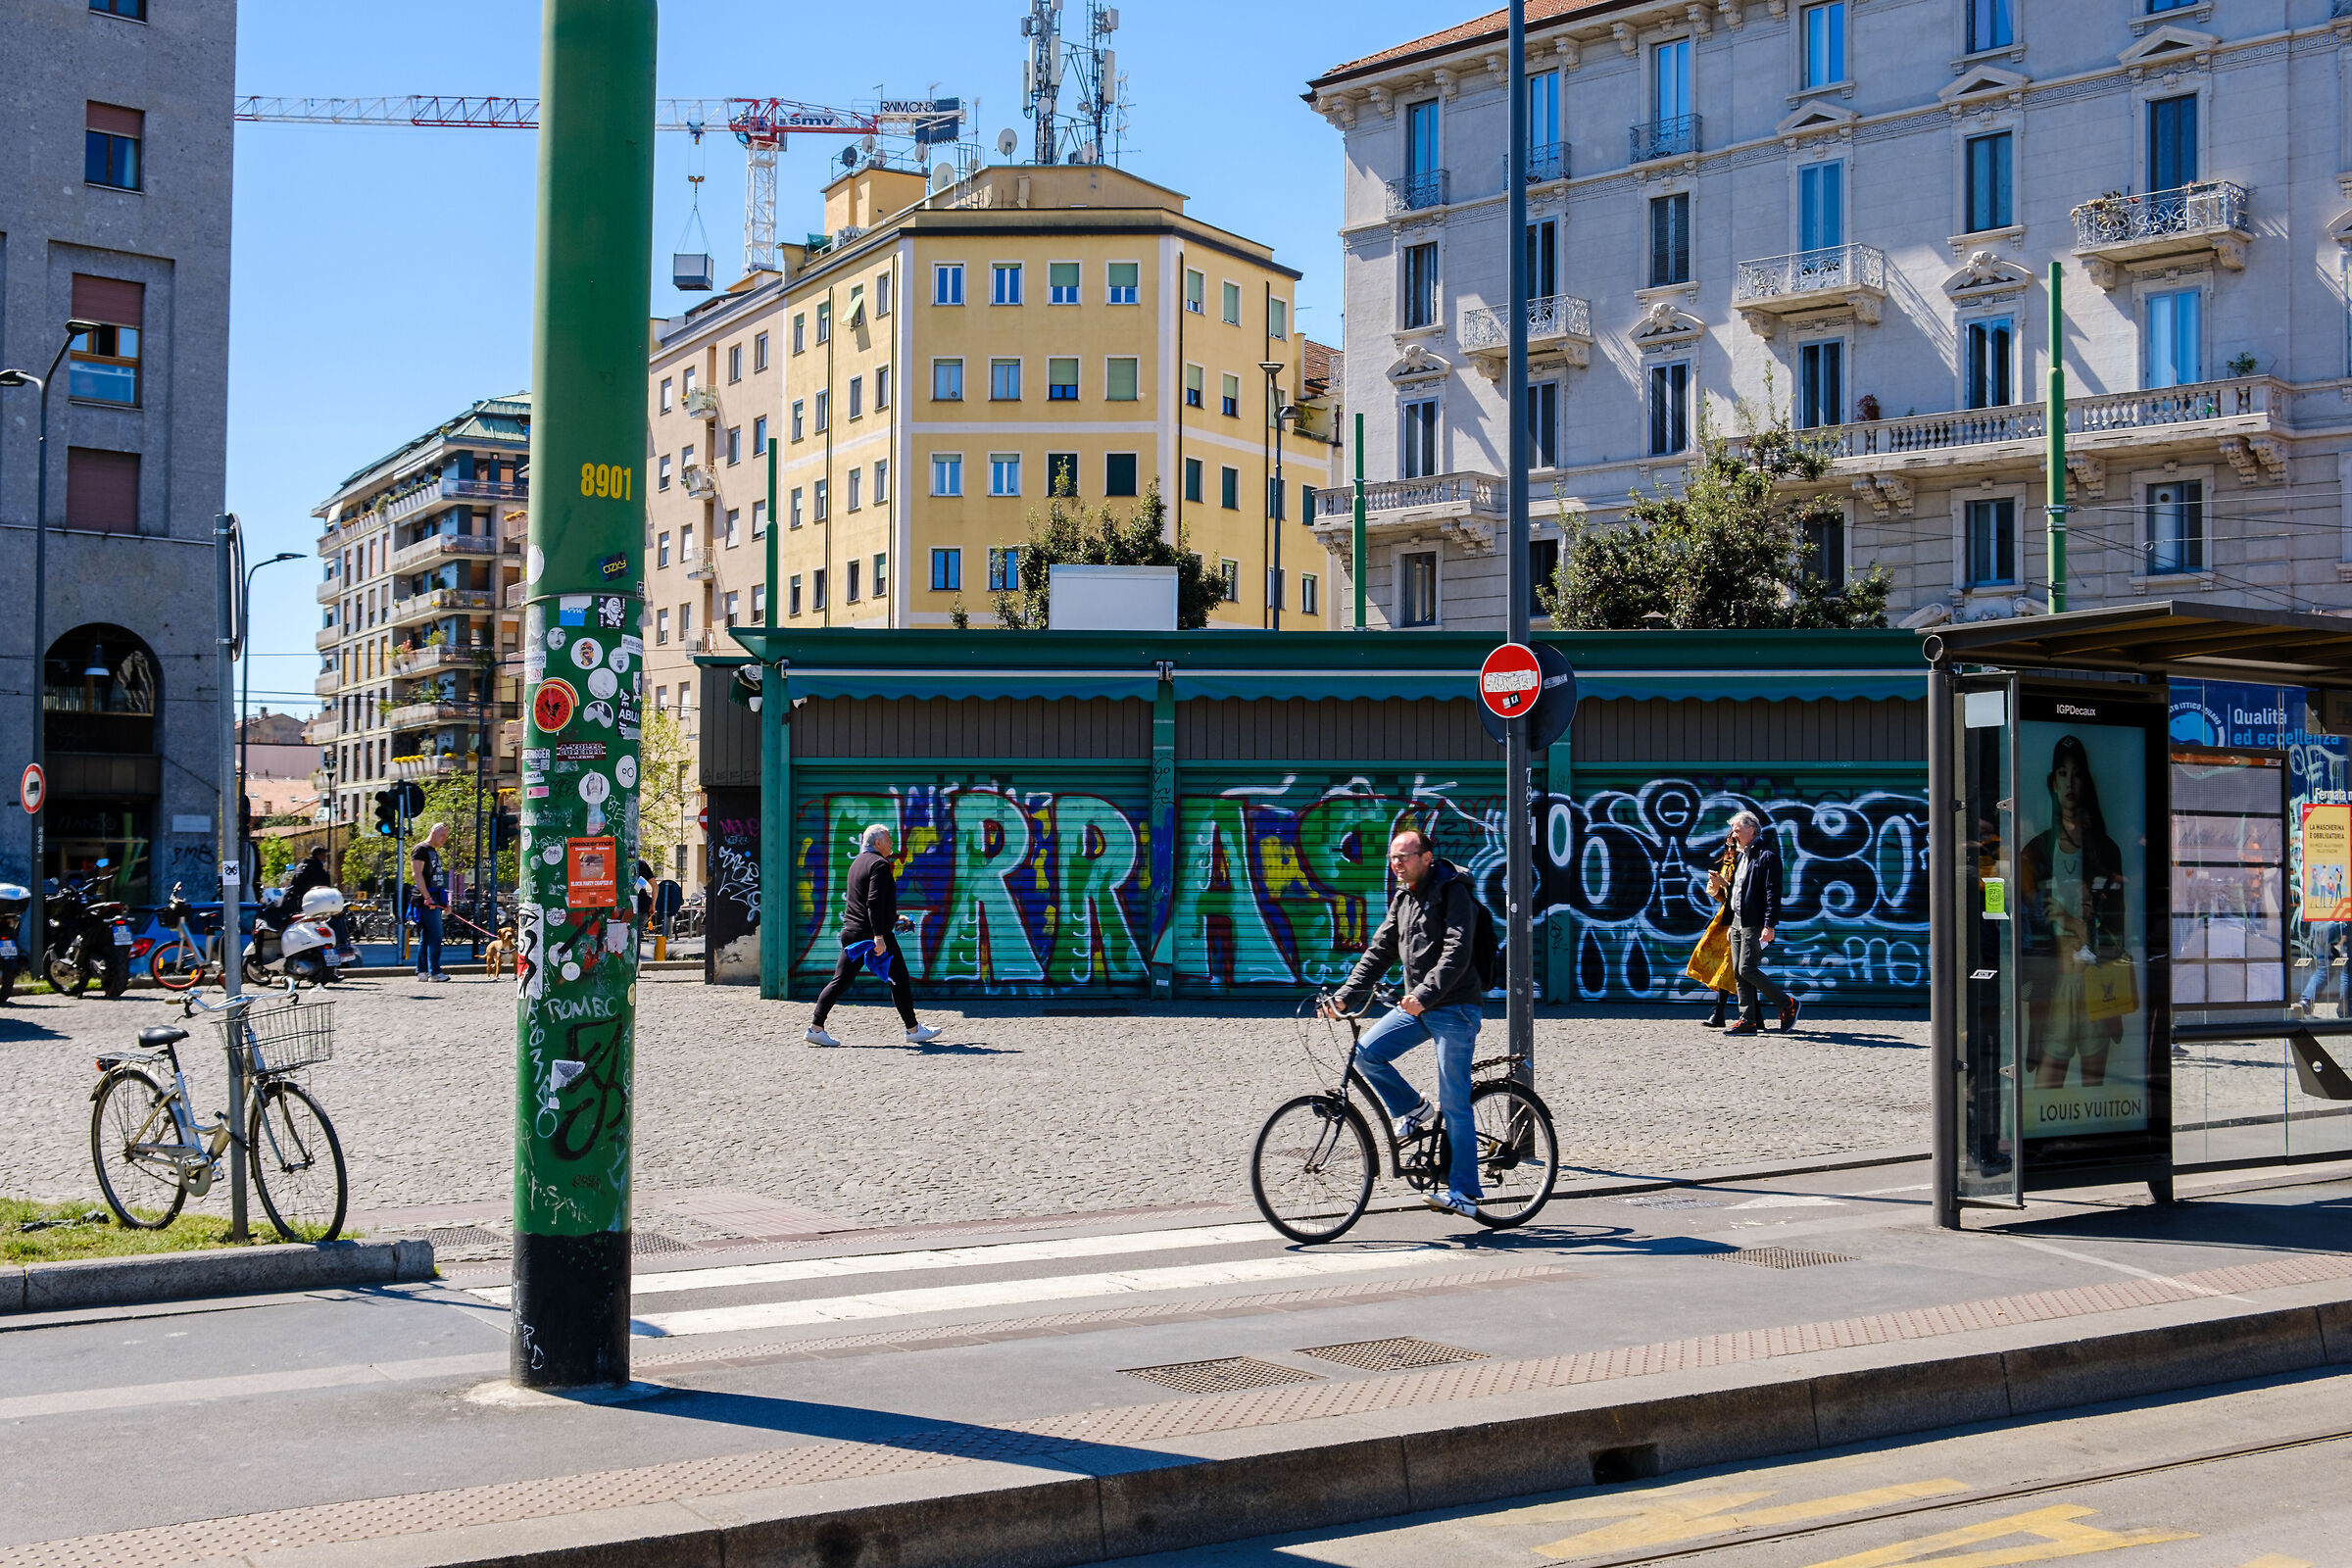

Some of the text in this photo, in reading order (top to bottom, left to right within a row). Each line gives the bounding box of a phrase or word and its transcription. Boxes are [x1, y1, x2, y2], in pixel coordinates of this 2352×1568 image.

[882, 101, 937, 113] RAIMONDI
[789, 117, 834, 125] smv
[580, 463, 631, 501] 8901
[2056, 704, 2096, 716] IGPDecaux
[2233, 728, 2252, 746] ed
[2039, 1099, 2141, 1122] LOUIS VUITTON
